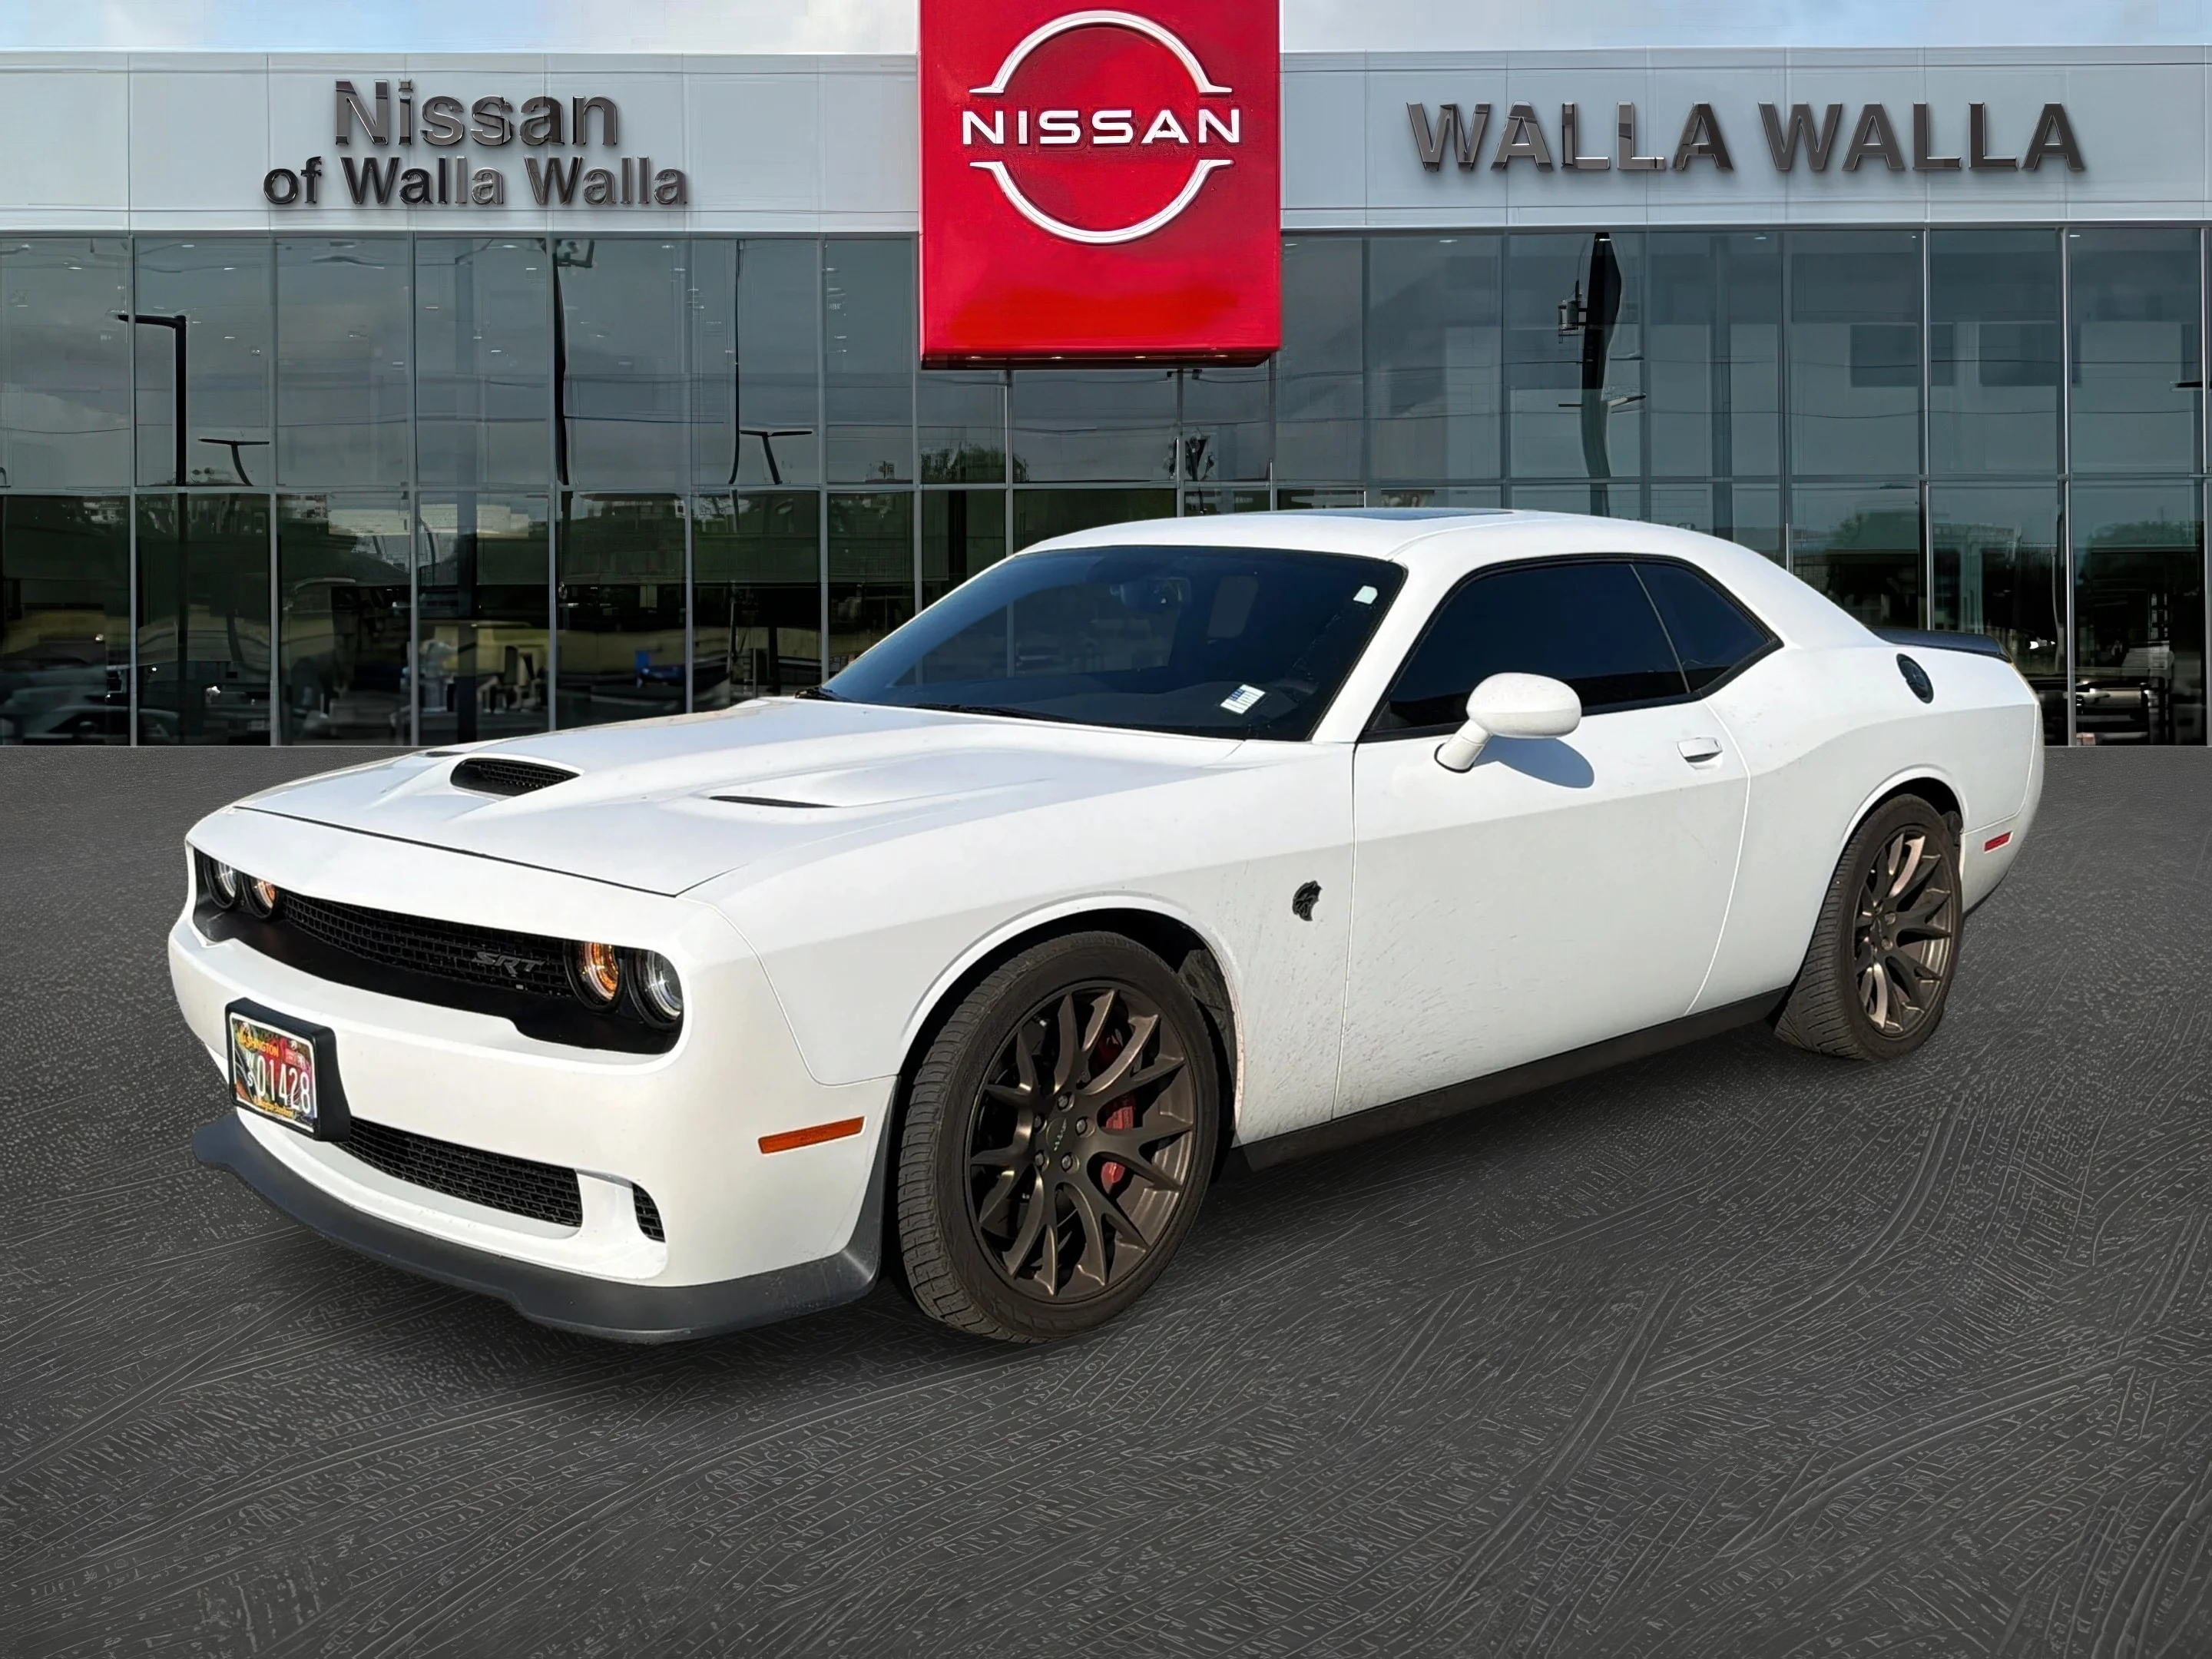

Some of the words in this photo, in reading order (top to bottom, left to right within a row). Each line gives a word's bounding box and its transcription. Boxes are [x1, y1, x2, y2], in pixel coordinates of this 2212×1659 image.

[334, 78, 618, 146] Nissan
[962, 108, 1241, 145] NISSAN
[1406, 101, 1734, 172] WALLA
[1757, 101, 2084, 172] WALLA
[262, 155, 323, 204] of
[340, 155, 505, 205] Walla
[524, 155, 689, 205] Walla
[471, 951, 546, 978] SRT
